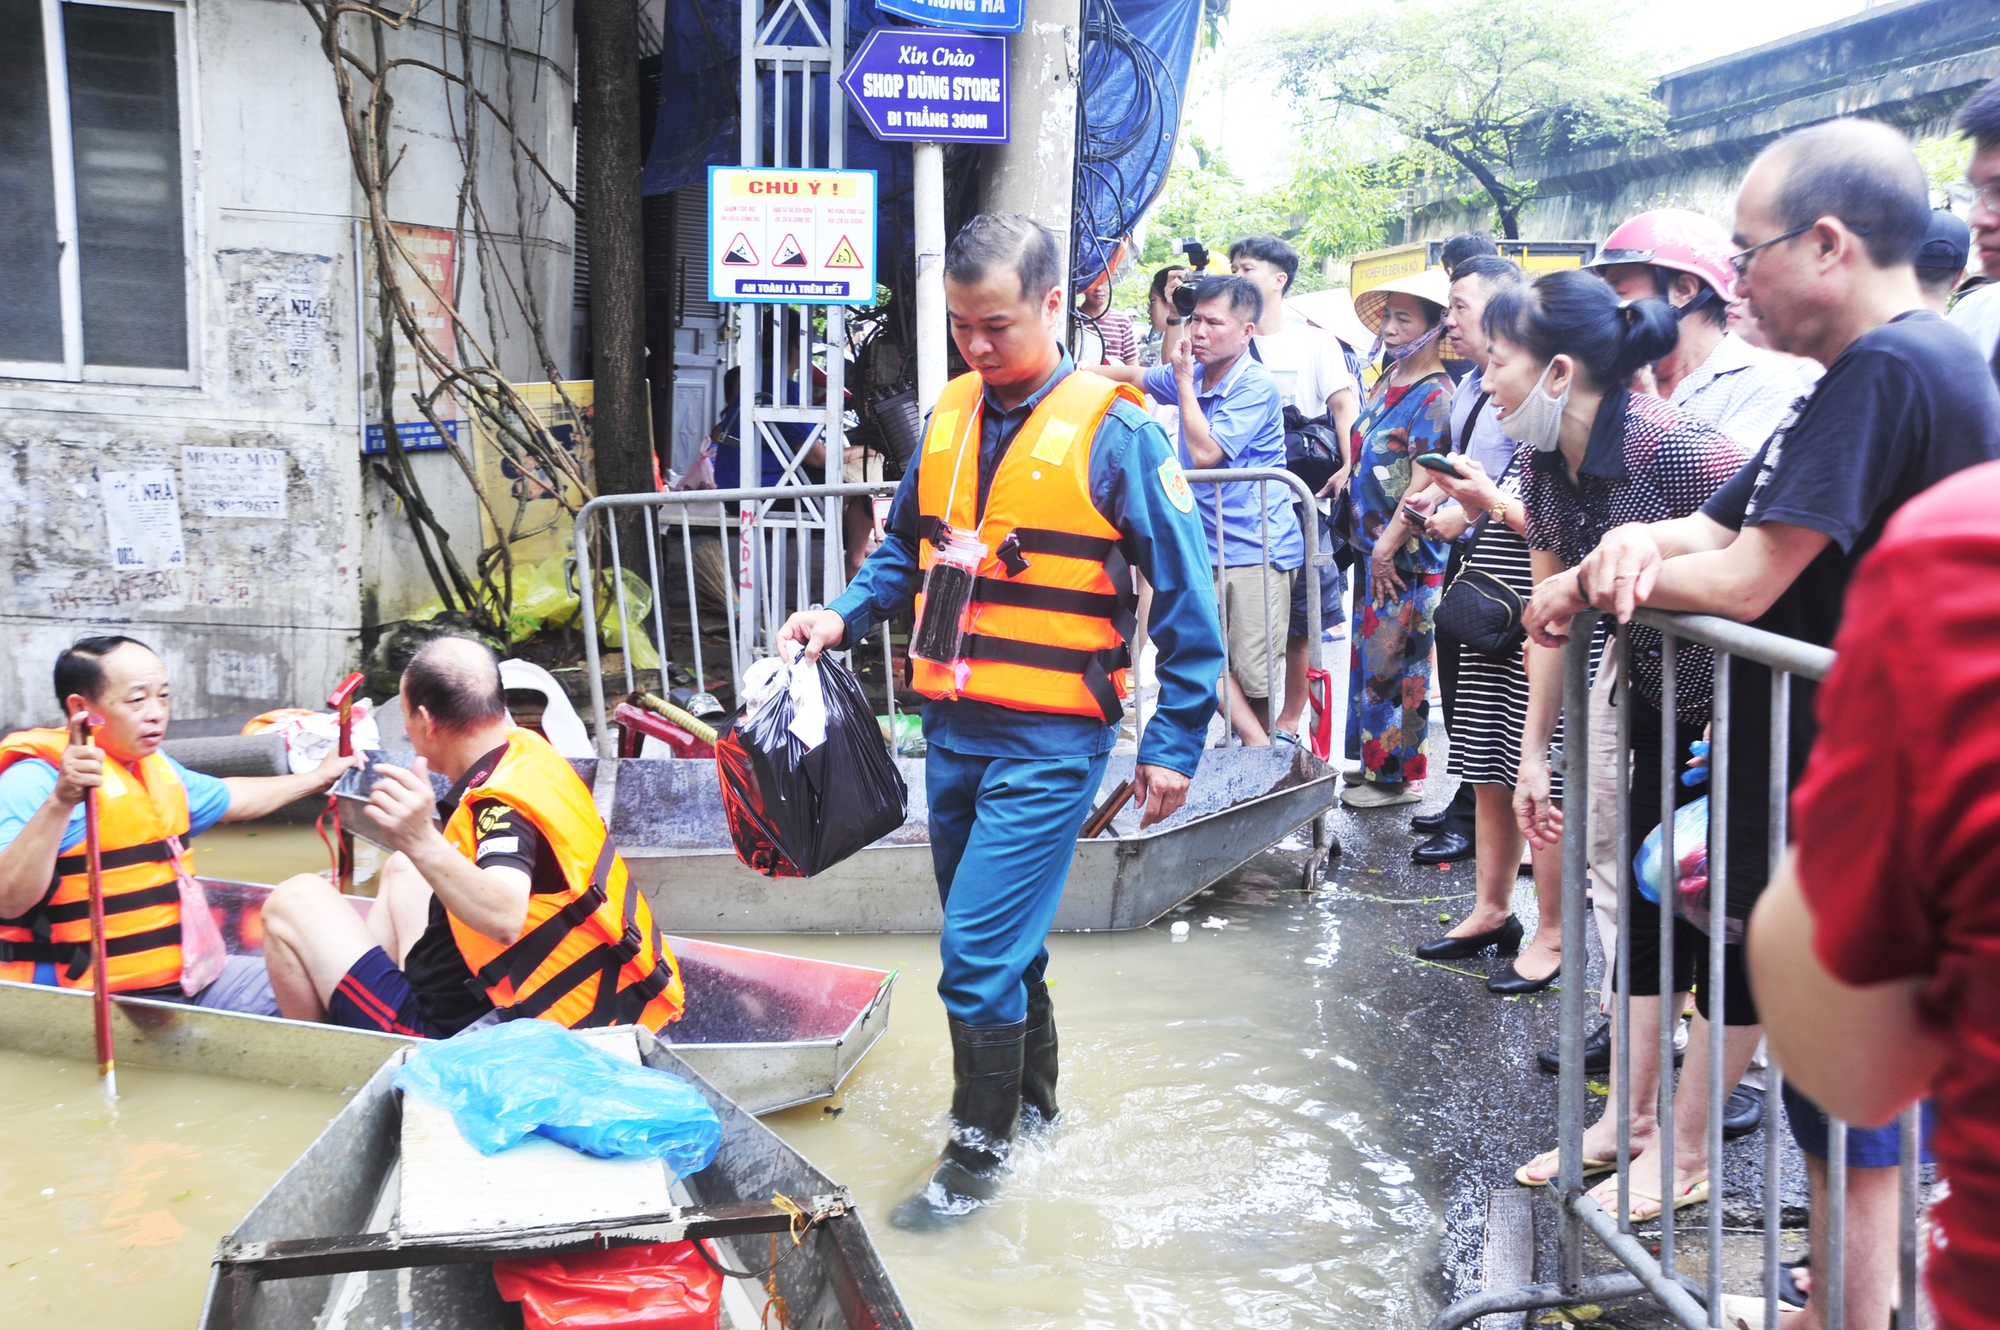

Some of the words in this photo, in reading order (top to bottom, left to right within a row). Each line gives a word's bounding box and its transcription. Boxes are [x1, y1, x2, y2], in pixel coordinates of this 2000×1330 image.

[898, 45, 928, 65] Xin
[932, 47, 975, 67] Chào
[863, 73, 904, 98] SHOP
[907, 70, 949, 100] DŨNG
[952, 77, 1000, 102] STORE
[887, 111, 902, 127] ĐI
[904, 105, 949, 128] THẲNG
[951, 112, 988, 129] 300M
[749, 179, 799, 195] CHÚ
[807, 180, 822, 195] Ý
[742, 283, 756, 293] AN
[757, 282, 783, 293] TOÀN
[784, 283, 798, 294] LÀ
[798, 283, 824, 294] TRÊN
[825, 283, 843, 295] HẾT
